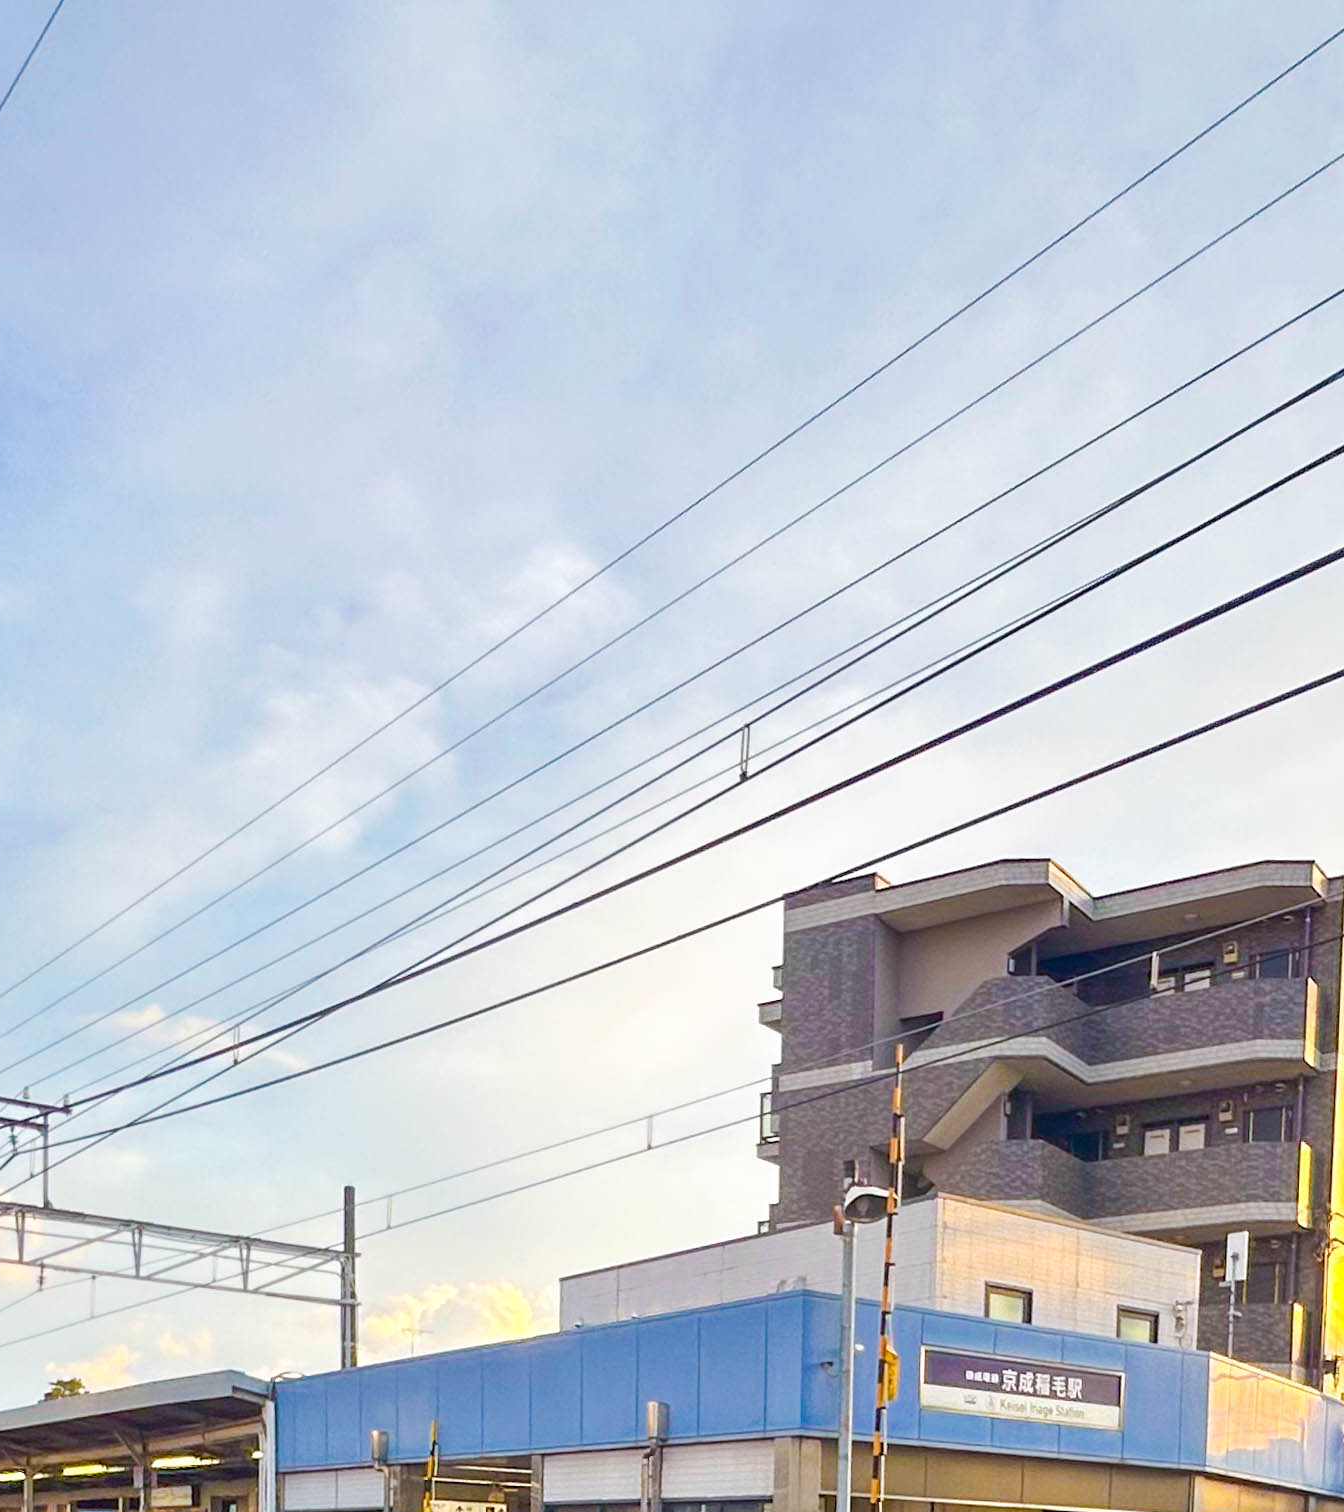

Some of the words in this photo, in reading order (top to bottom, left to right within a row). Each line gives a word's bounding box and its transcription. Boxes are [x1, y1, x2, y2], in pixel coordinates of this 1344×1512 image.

[1001, 1369, 1083, 1400] 京成稲毛駅
